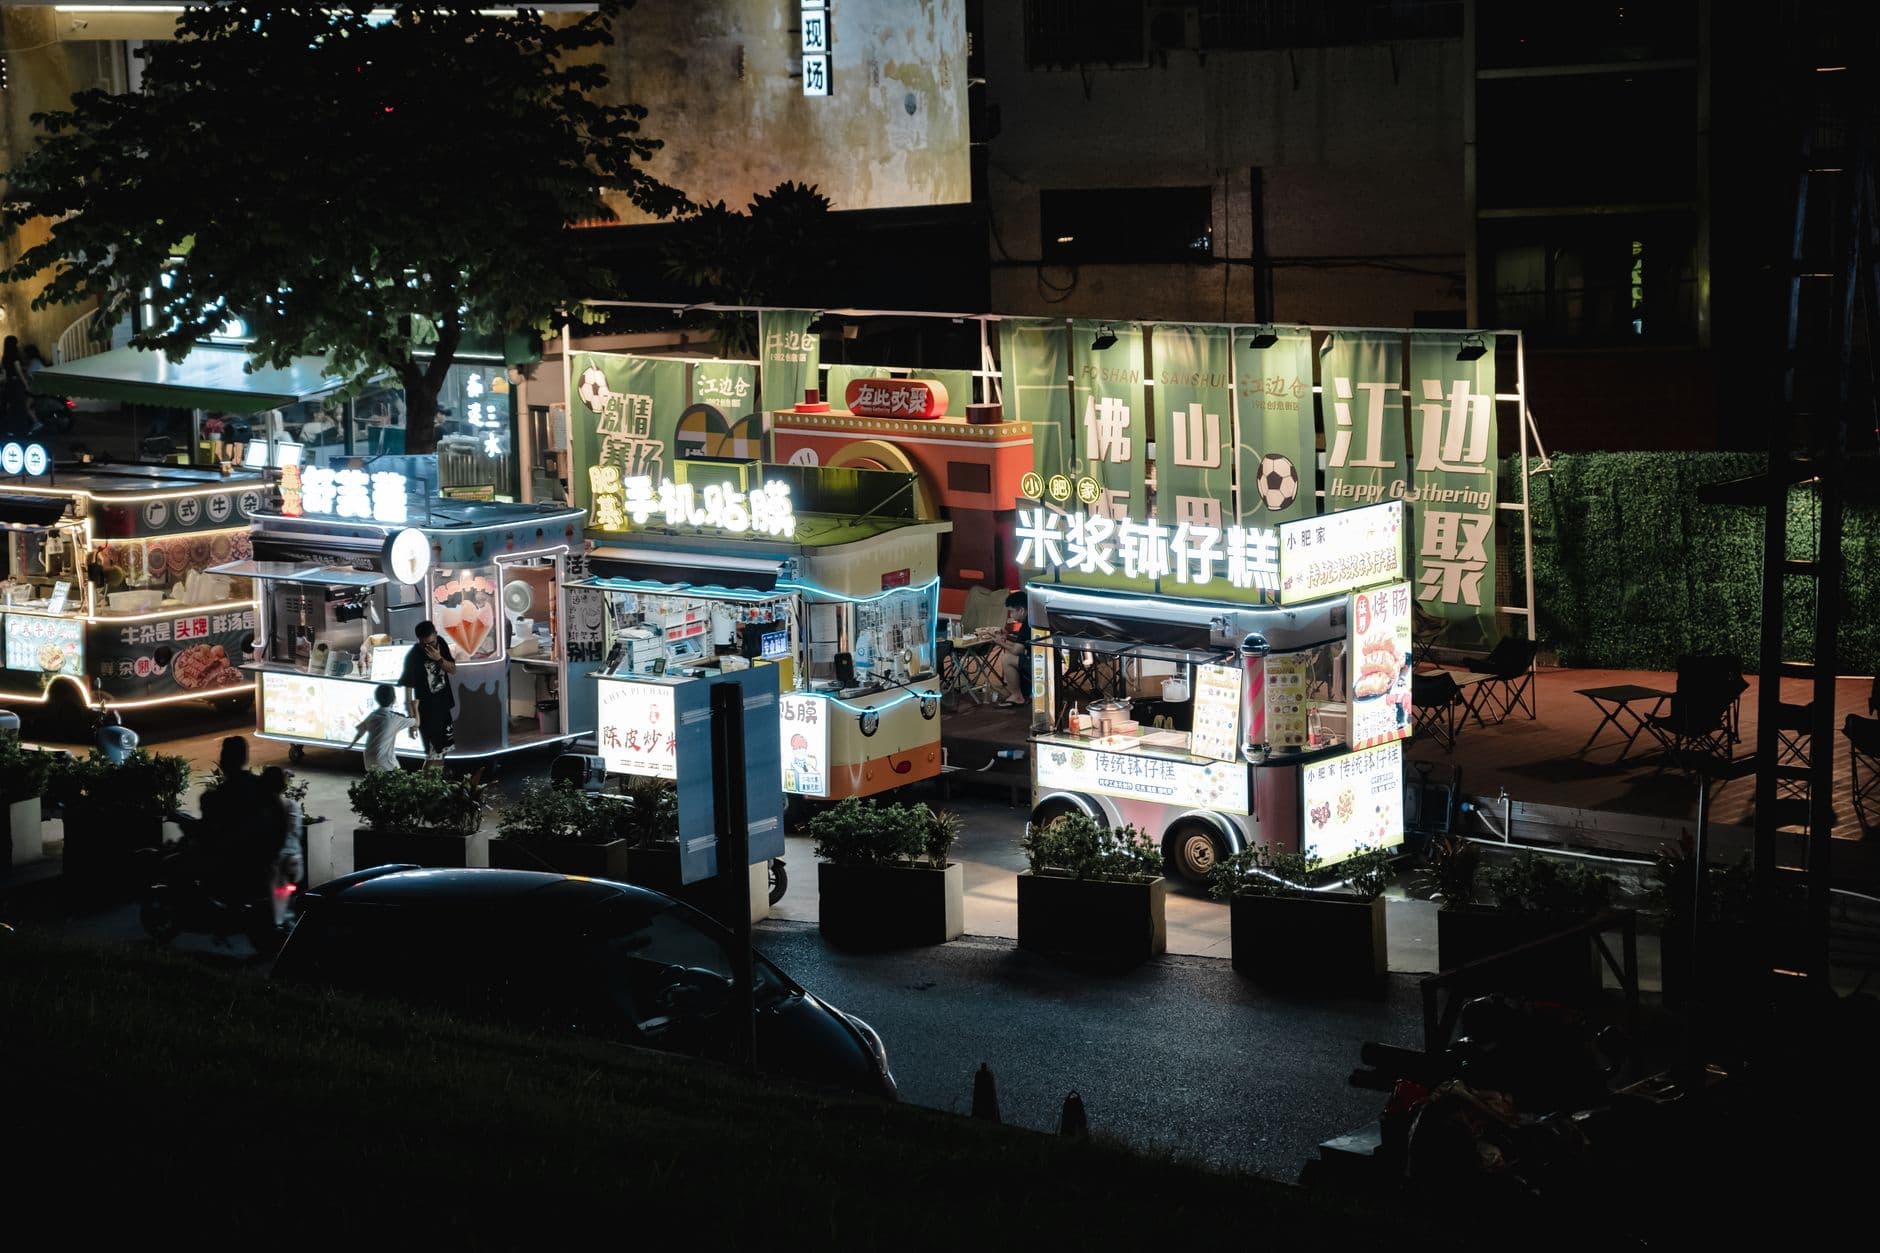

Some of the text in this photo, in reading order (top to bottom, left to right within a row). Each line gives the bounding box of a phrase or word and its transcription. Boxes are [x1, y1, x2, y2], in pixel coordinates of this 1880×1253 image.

[806, 19, 823, 90] 现场
[697, 375, 751, 397] 江边仓
[1161, 372, 1226, 388] SANSHUI
[1240, 376, 1310, 399] 江边仓
[850, 384, 928, 413] 在此欢聚
[1024, 475, 1099, 502] 小肥家
[1331, 478, 1492, 510] Happy Gathering
[149, 493, 260, 520] 广式牛杂
[624, 475, 797, 537] 手机贴膜
[1016, 507, 1280, 590] 米浆钵仔糕
[1287, 526, 1326, 550] 小肥家
[1418, 511, 1493, 606] 聚
[1374, 588, 1408, 623] 烤肠
[1096, 752, 1177, 780] 传统钵仔糕
